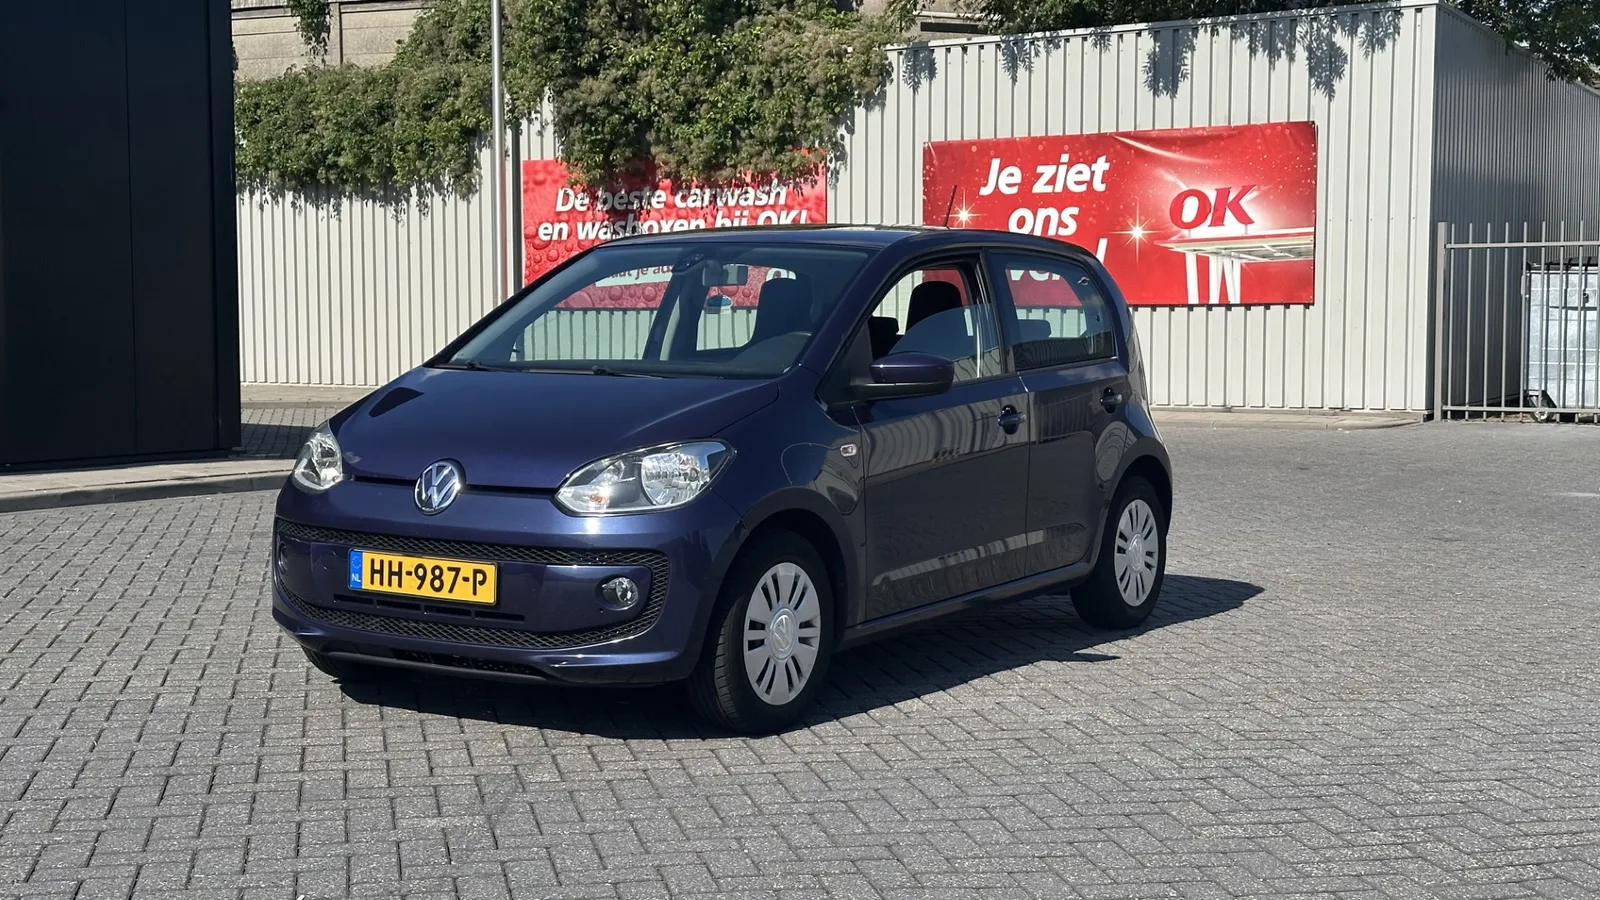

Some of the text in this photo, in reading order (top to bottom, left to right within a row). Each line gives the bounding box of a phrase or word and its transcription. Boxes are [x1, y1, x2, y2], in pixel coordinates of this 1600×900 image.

[979, 153, 1110, 195] Je ziet
[556, 179, 787, 212] De beste carwash
[1169, 184, 1257, 230] OK
[538, 221, 569, 240] en
[577, 213, 706, 240] wasboxen
[1008, 206, 1080, 236] ons
[351, 573, 362, 583] NL
[370, 558, 487, 597] HH-987-P
